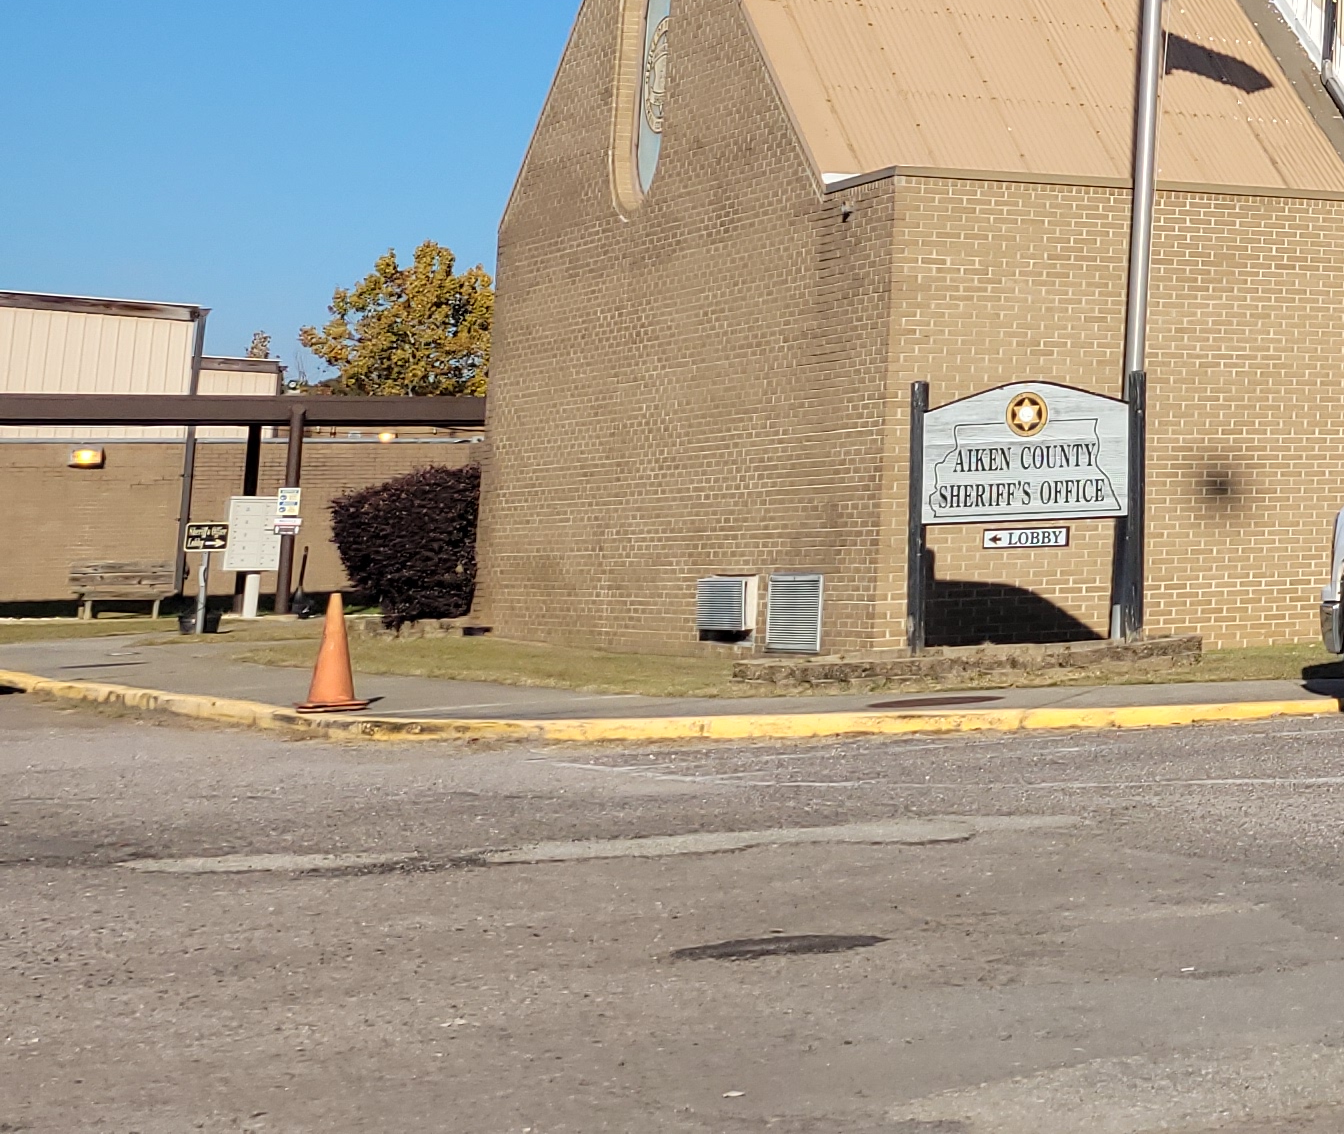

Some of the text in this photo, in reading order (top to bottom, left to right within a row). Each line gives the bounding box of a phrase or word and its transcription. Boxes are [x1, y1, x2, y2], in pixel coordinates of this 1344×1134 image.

[953, 443, 1097, 473] AIKEN COUNTY
[938, 478, 1105, 509] SHERIFF'S OFFICE
[1007, 530, 1063, 546] LOBBY
